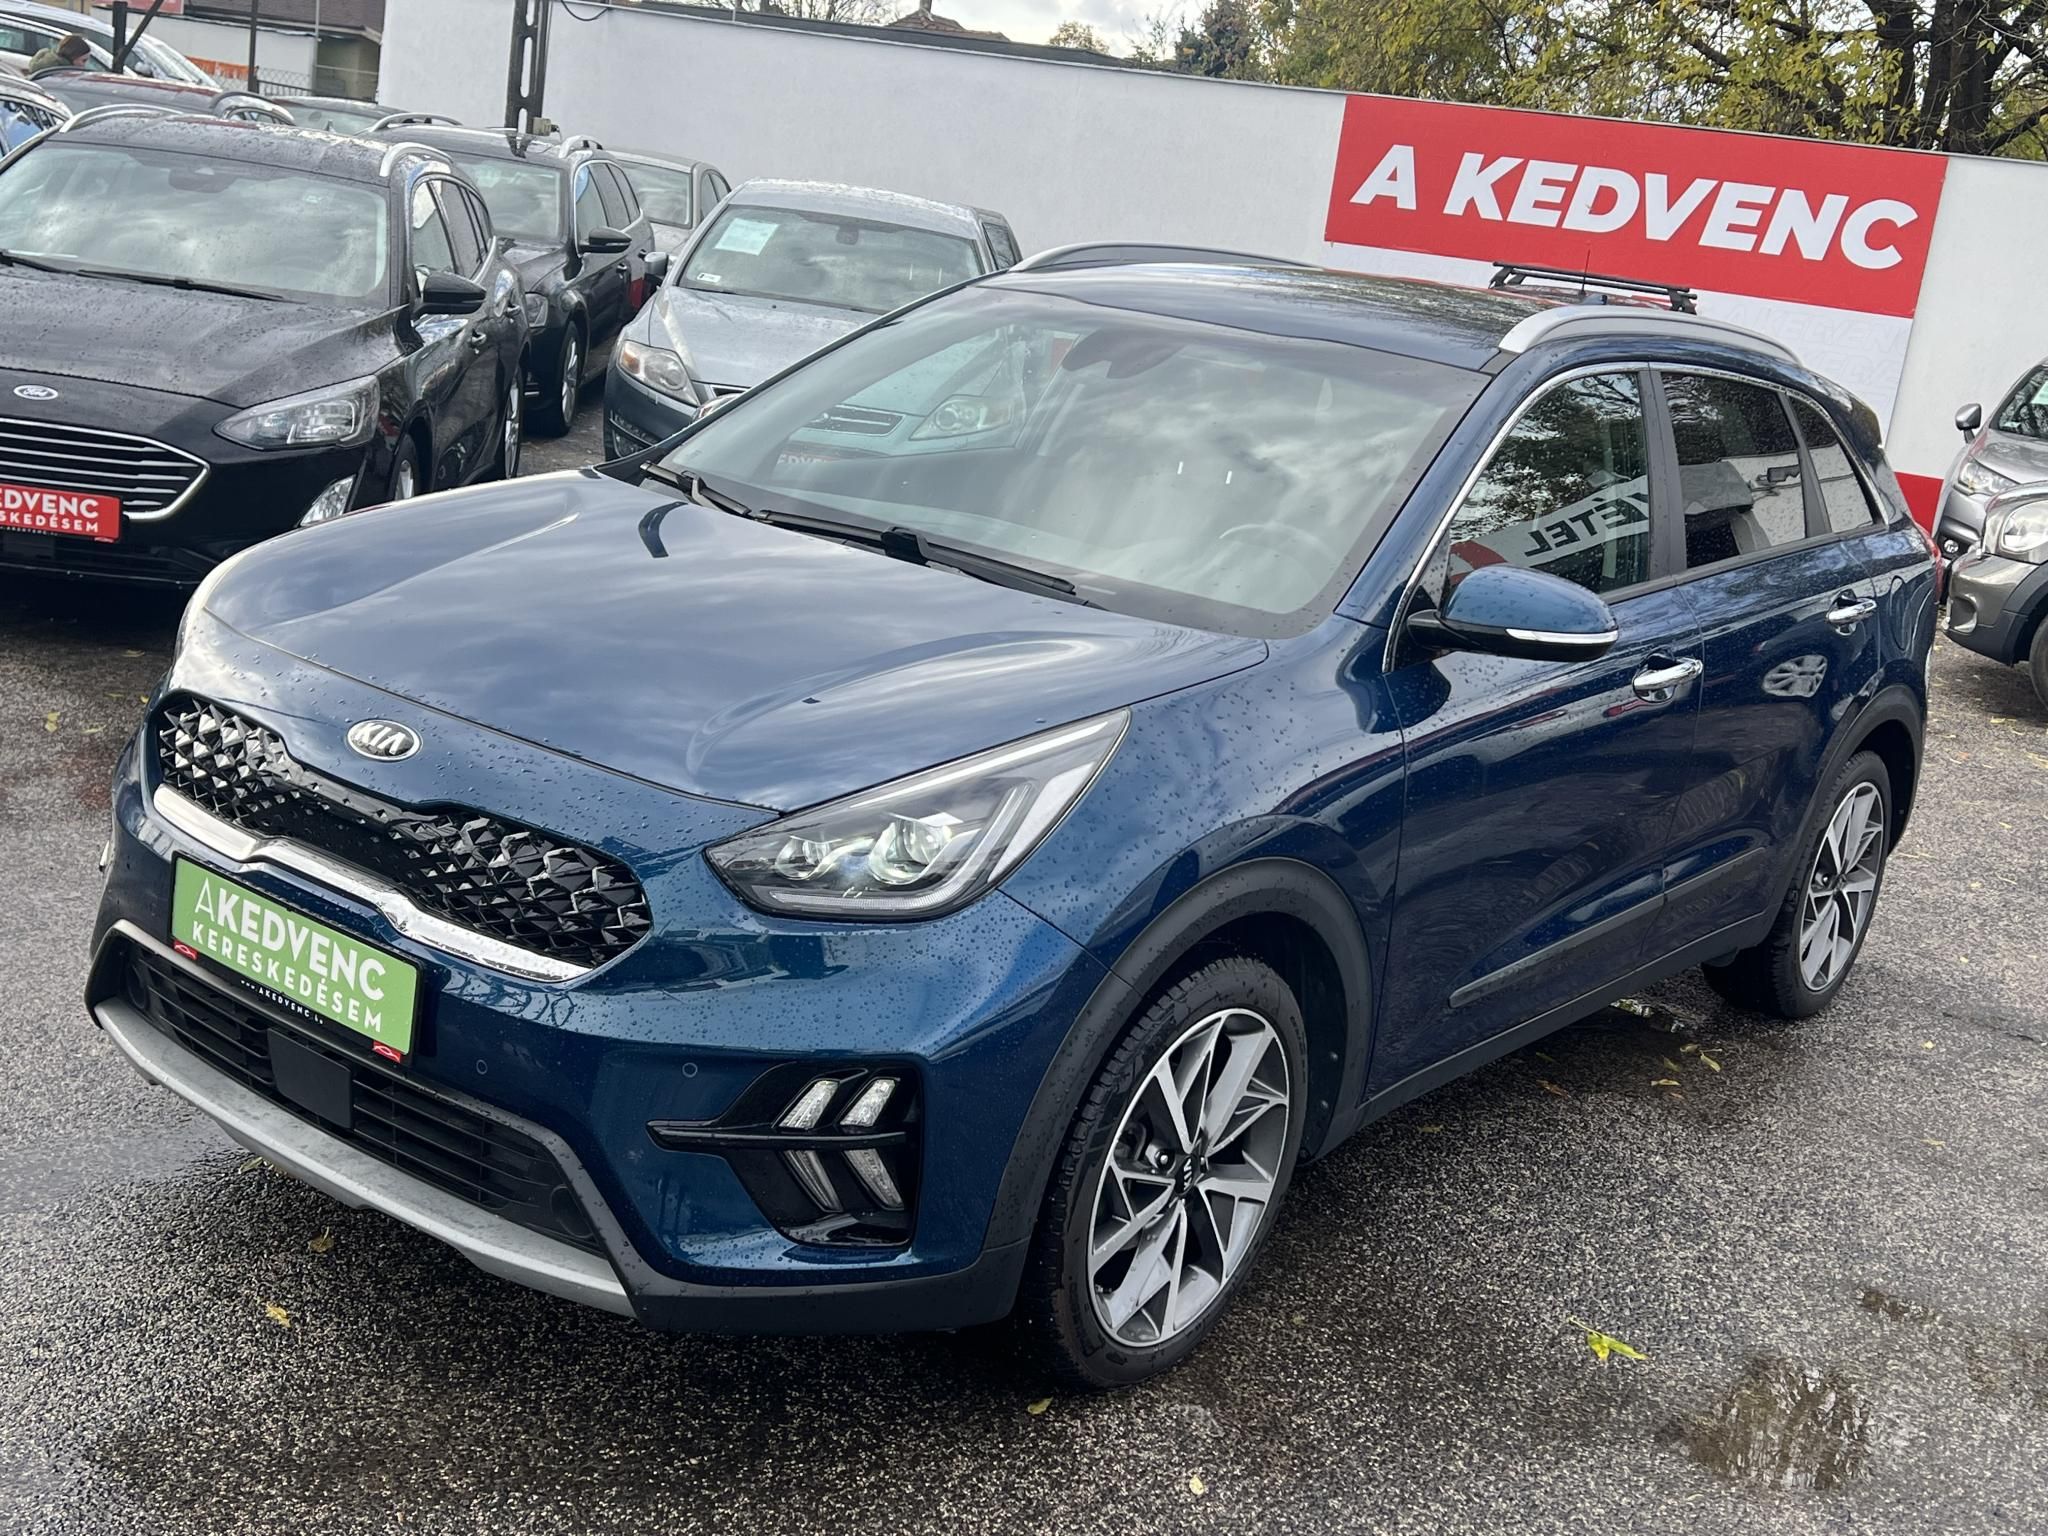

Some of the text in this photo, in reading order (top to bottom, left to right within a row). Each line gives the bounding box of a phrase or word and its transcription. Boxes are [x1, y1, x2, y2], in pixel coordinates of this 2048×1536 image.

[1349, 143, 1918, 270] A KEDVENC
[0, 488, 99, 518] DVENC
[354, 722, 407, 756] KIA
[192, 920, 382, 1033] KERESKEDÉSEM
